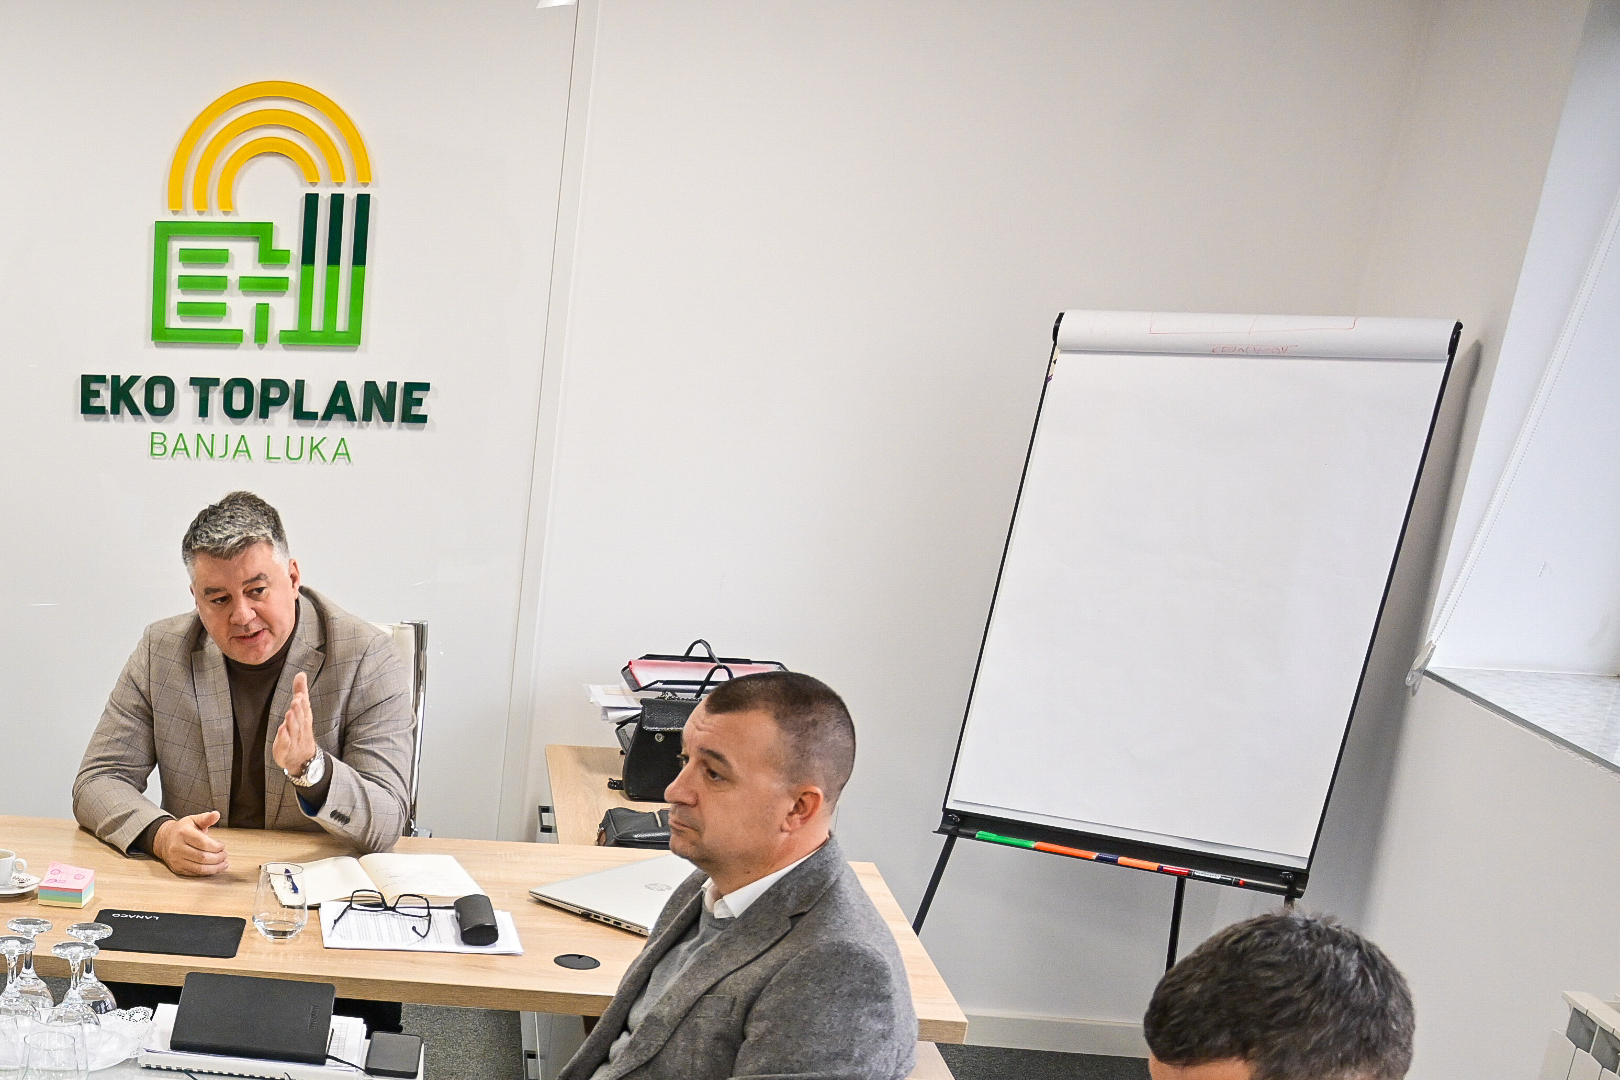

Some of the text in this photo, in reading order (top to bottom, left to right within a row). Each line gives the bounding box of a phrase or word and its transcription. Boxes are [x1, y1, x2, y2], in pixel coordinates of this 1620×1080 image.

[80, 374, 430, 424] EKO TOPLANE
[149, 431, 352, 464] BANJA LUKA
[111, 913, 159, 921] LANACO
